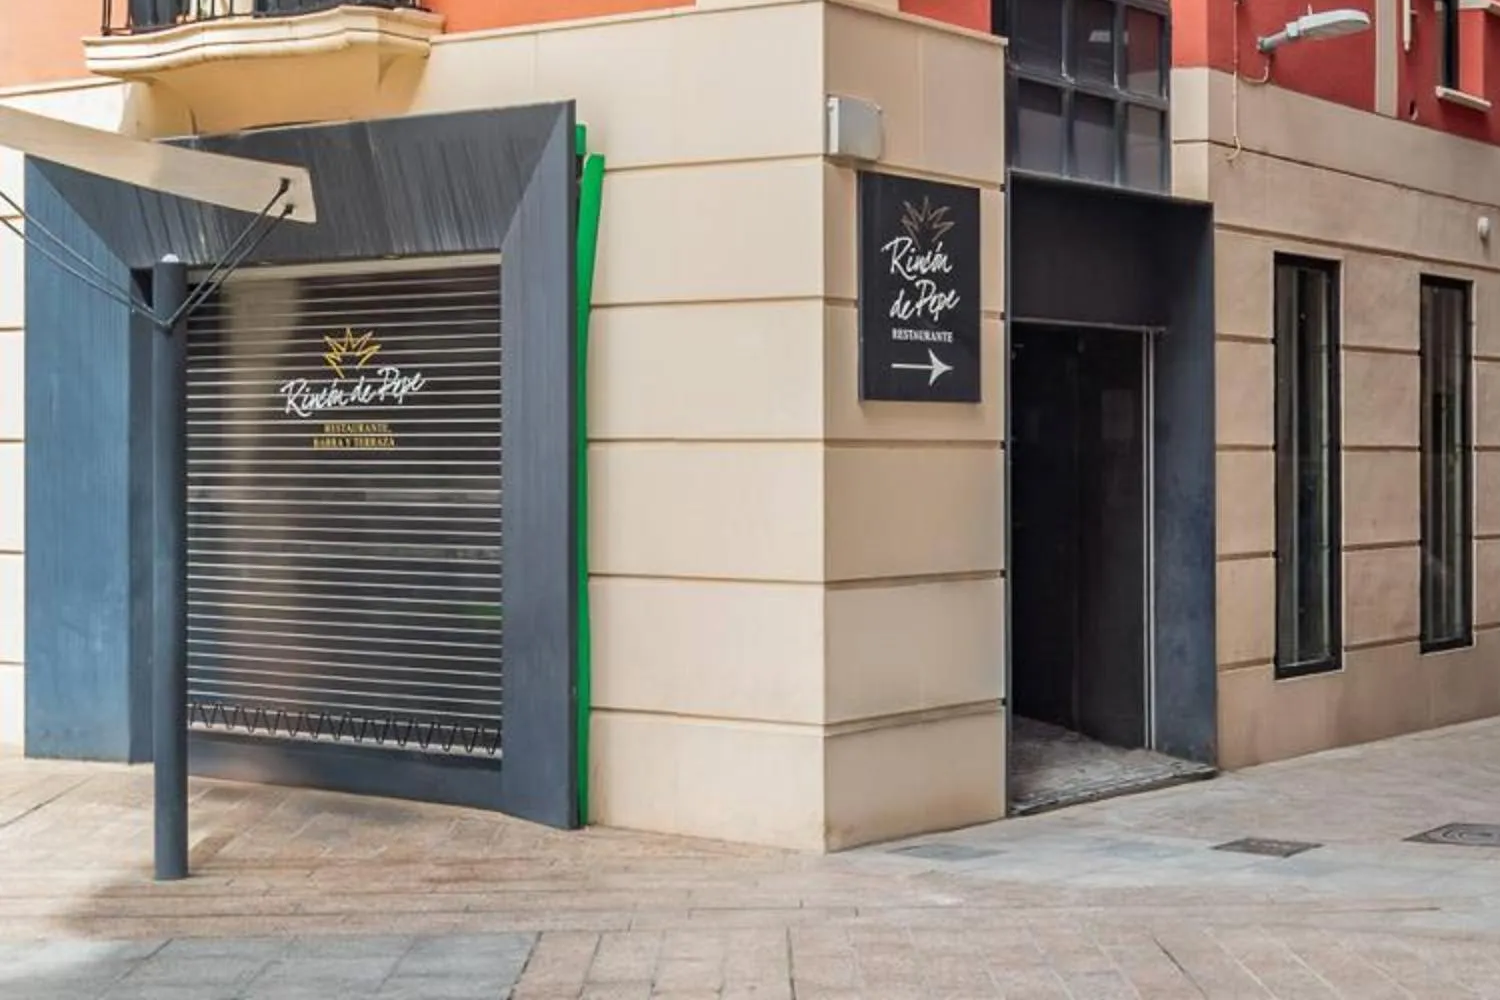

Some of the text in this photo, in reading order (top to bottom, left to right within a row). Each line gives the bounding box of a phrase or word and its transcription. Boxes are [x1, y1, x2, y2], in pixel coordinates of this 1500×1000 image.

[880, 235, 954, 281] Rincón
[889, 278, 961, 322] de Pepe
[891, 326, 954, 344] RESTAURANTE
[279, 365, 426, 418] Rincón de Pepe
